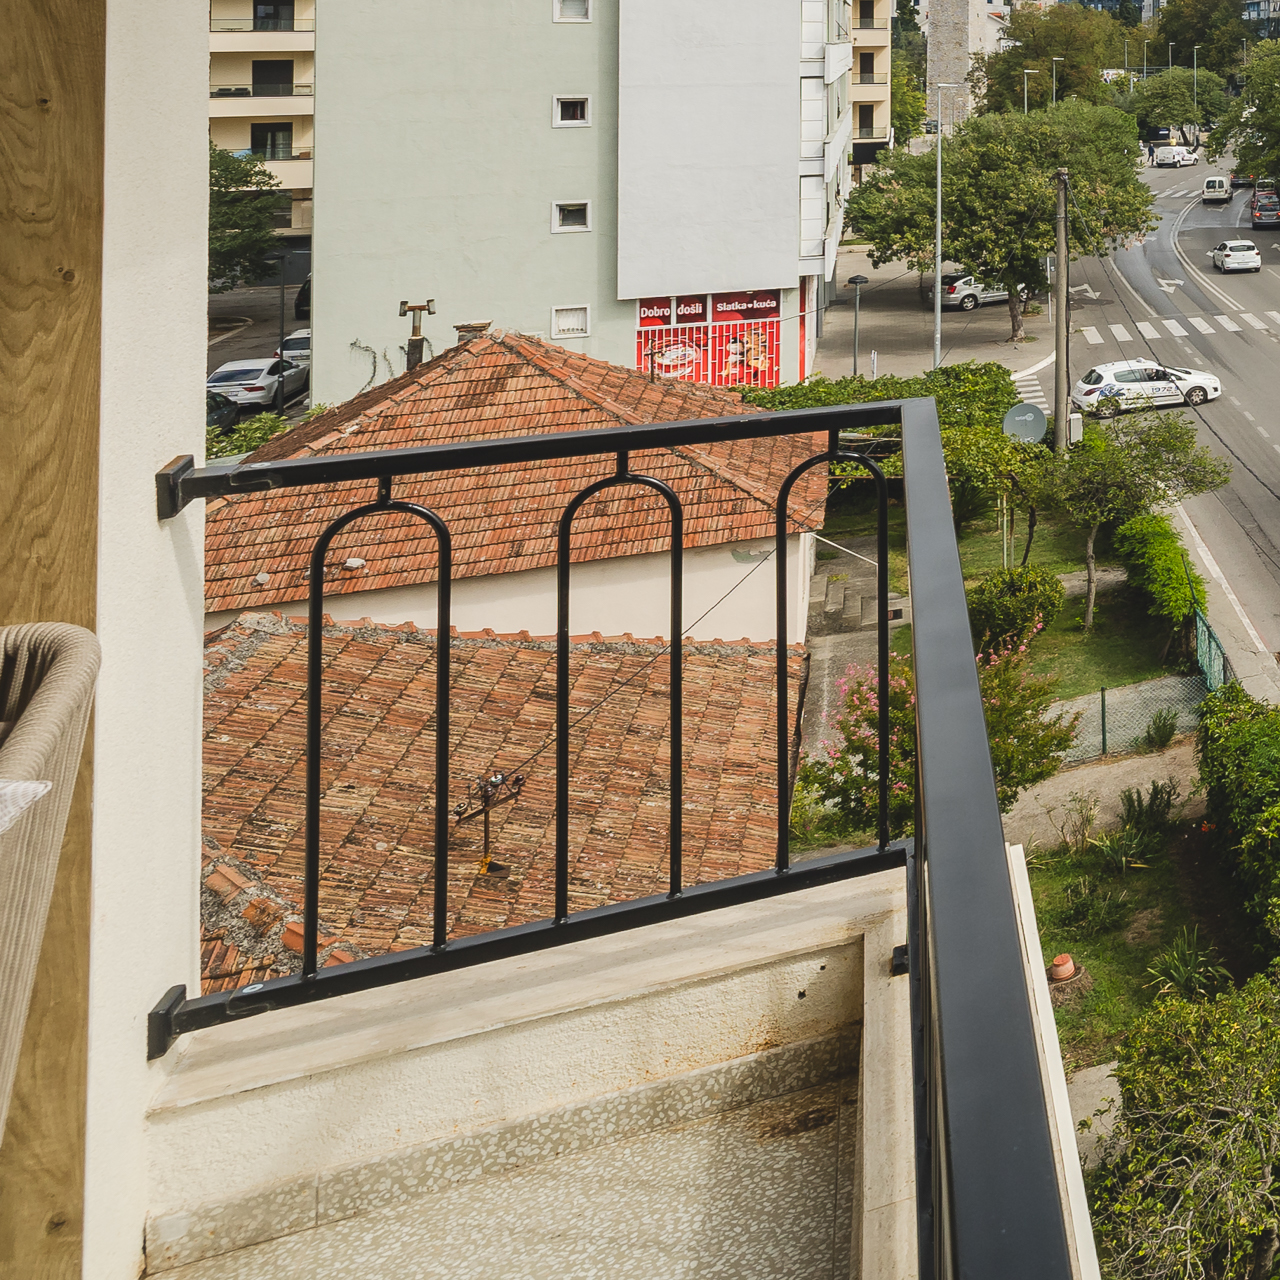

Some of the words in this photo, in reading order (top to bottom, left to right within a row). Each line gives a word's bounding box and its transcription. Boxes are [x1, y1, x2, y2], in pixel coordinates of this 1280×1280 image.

[640, 306, 671, 318] Dobro
[677, 303, 703, 315] došli
[716, 301, 747, 312] Slatka
[753, 299, 777, 309] kuća
